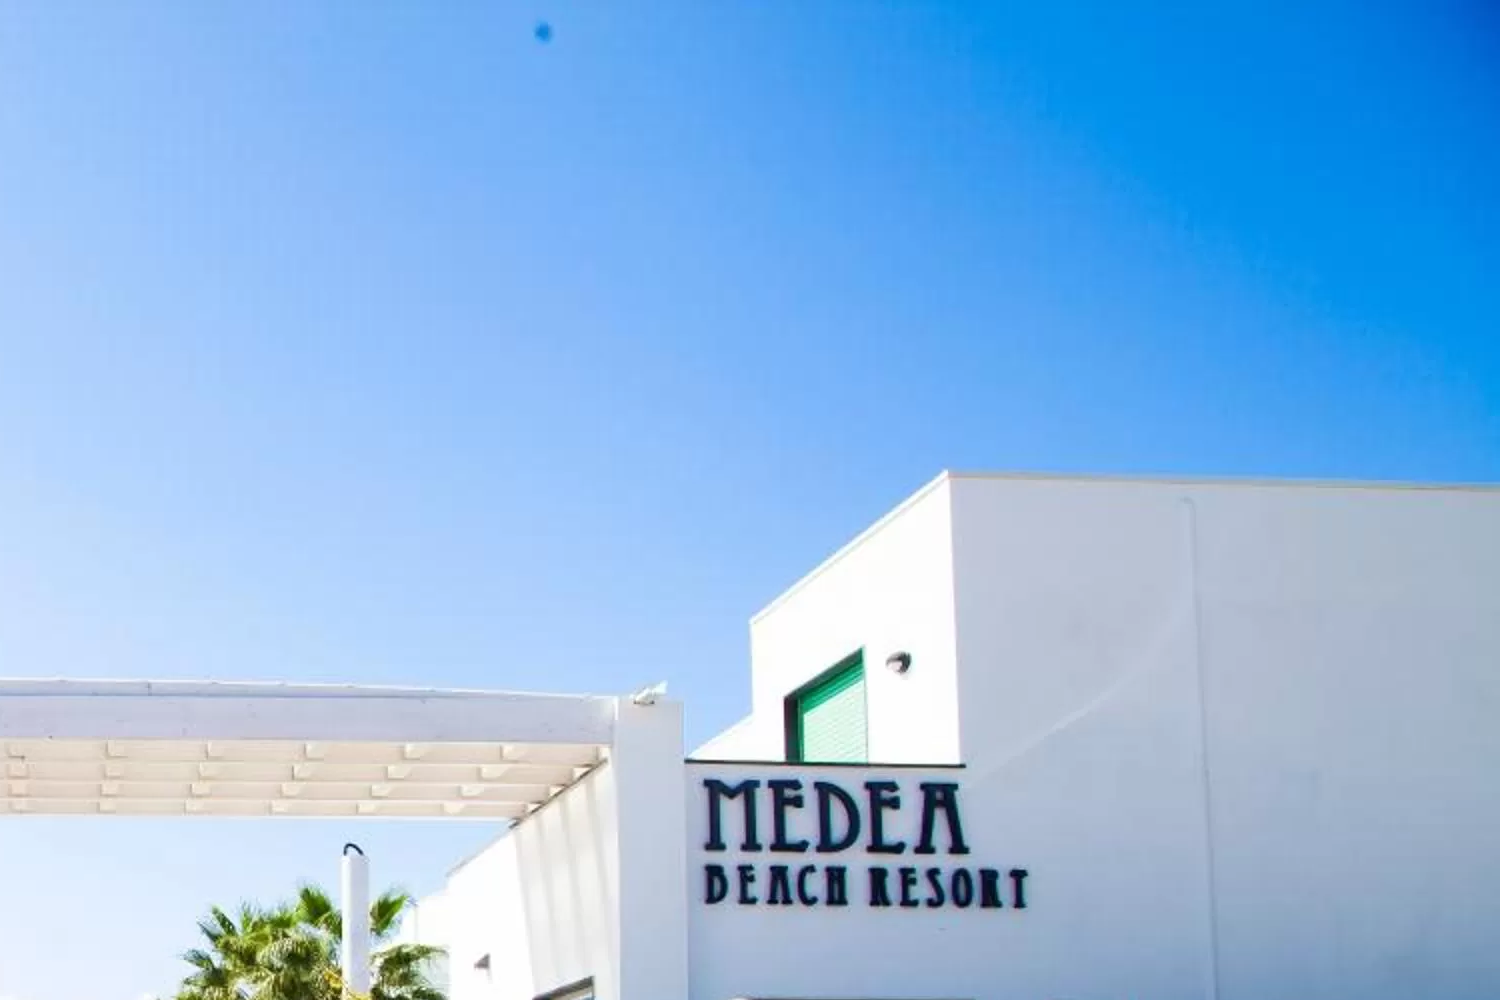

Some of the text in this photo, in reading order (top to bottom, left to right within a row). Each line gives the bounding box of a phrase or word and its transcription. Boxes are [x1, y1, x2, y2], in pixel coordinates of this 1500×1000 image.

[703, 779, 971, 855] MEDEA
[704, 864, 1029, 909] BEACH RESORT
